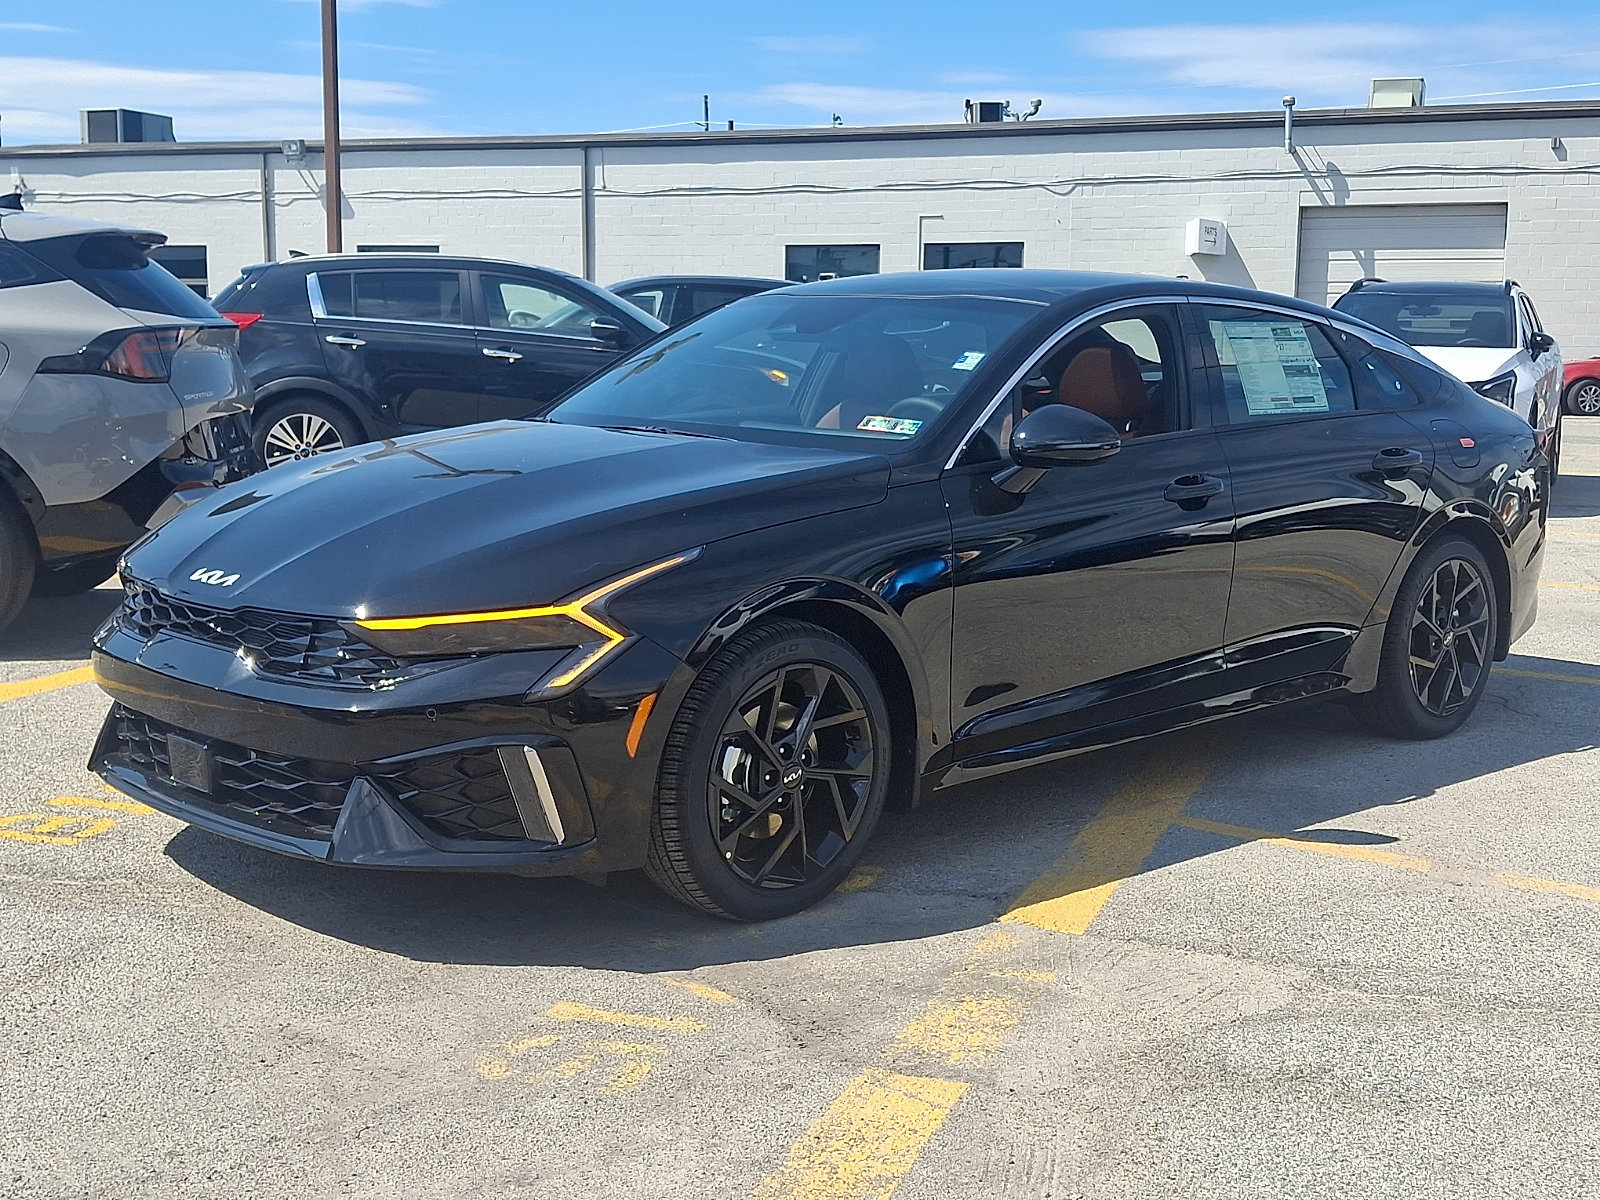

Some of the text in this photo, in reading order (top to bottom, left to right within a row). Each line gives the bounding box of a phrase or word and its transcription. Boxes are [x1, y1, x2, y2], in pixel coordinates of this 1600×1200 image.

[1203, 225, 1218, 237] PARTS
[189, 567, 241, 587] KIA
[783, 768, 802, 784] KIA
